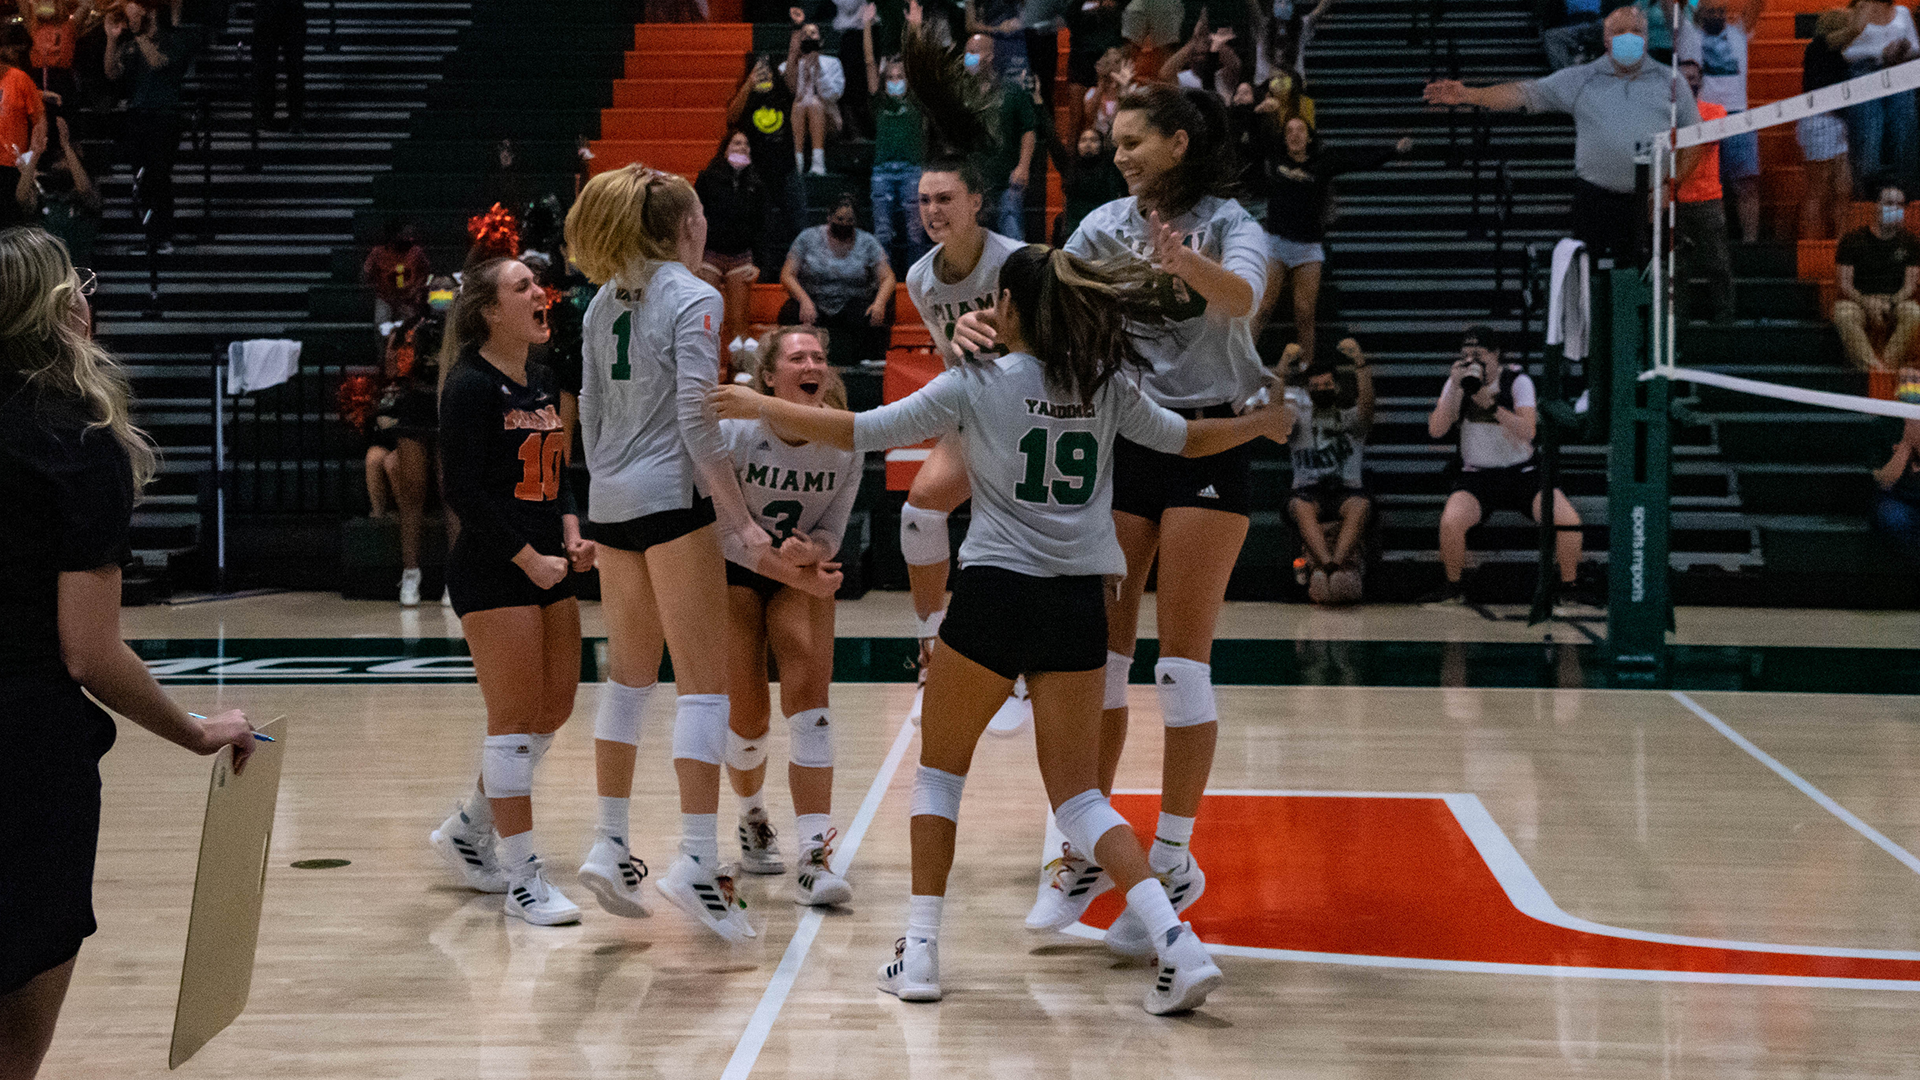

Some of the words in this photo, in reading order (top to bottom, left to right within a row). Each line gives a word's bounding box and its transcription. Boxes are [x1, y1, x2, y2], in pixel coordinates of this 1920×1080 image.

[932, 291, 995, 321] MIAM
[611, 310, 632, 381] 1
[514, 431, 564, 502] 10
[745, 462, 836, 492] MIAMI
[1013, 426, 1099, 507] 19
[762, 500, 803, 548] 3
